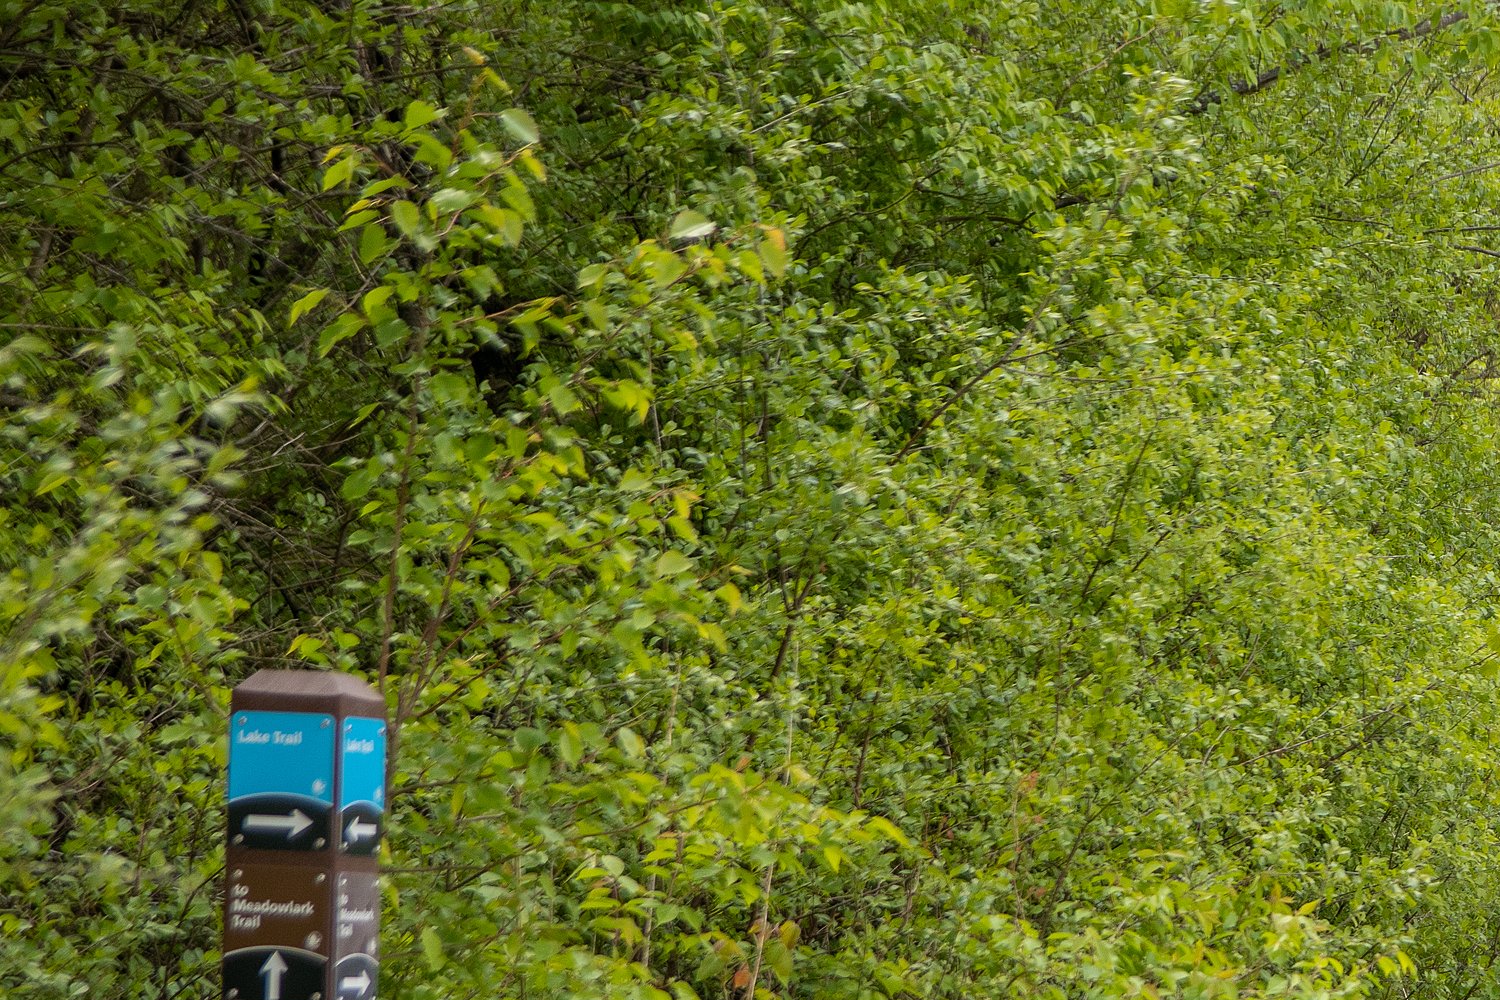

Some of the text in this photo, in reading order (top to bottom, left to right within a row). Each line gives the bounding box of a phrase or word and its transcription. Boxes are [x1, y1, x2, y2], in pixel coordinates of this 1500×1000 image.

[238, 730, 303, 745] Lake Trail
[233, 883, 250, 898] to
[230, 899, 315, 916] Meadowlark
[231, 914, 261, 929] Trail
